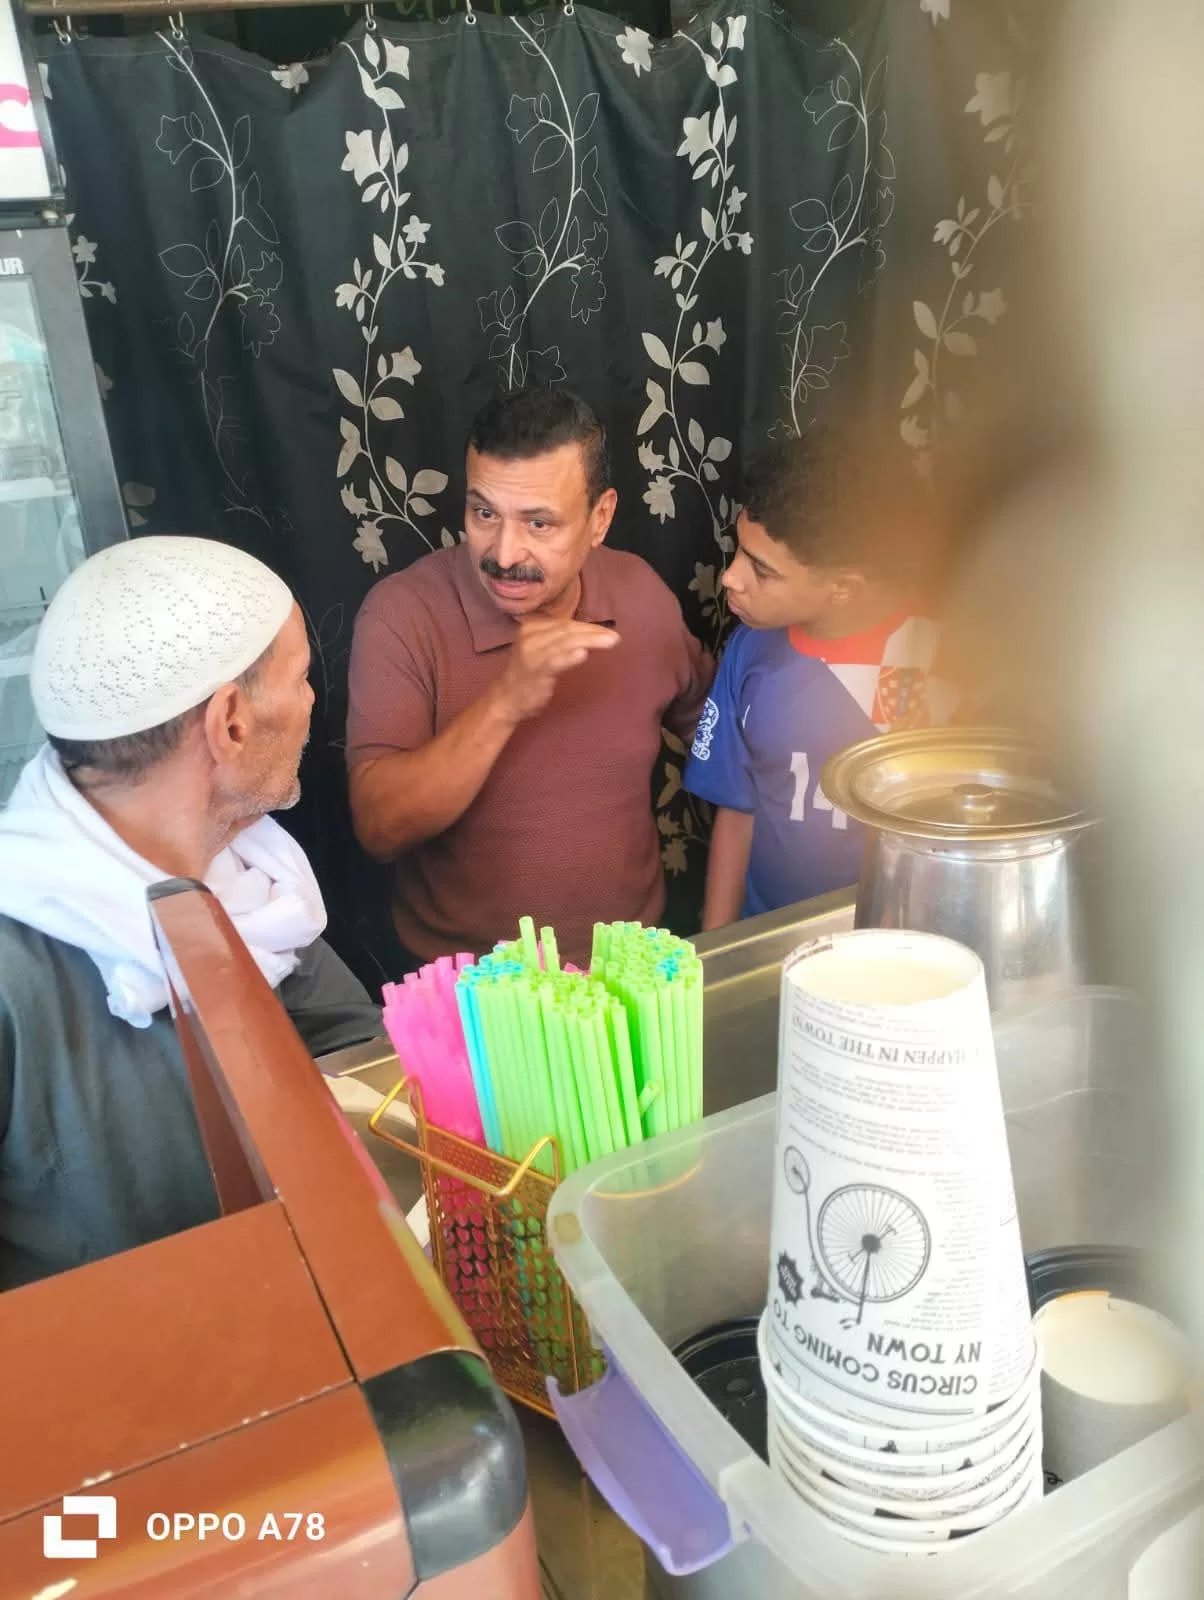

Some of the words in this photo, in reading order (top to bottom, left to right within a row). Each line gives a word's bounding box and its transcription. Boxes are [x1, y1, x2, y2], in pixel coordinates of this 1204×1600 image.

[838, 1035, 875, 1059] THE
[878, 1046, 899, 1064] IN
[773, 1298, 790, 1333] TO
[793, 1324, 880, 1383] COMING
[867, 1331, 946, 1365] TOWN
[954, 1341, 982, 1365] NY
[887, 1369, 978, 1396] CIRCUS
